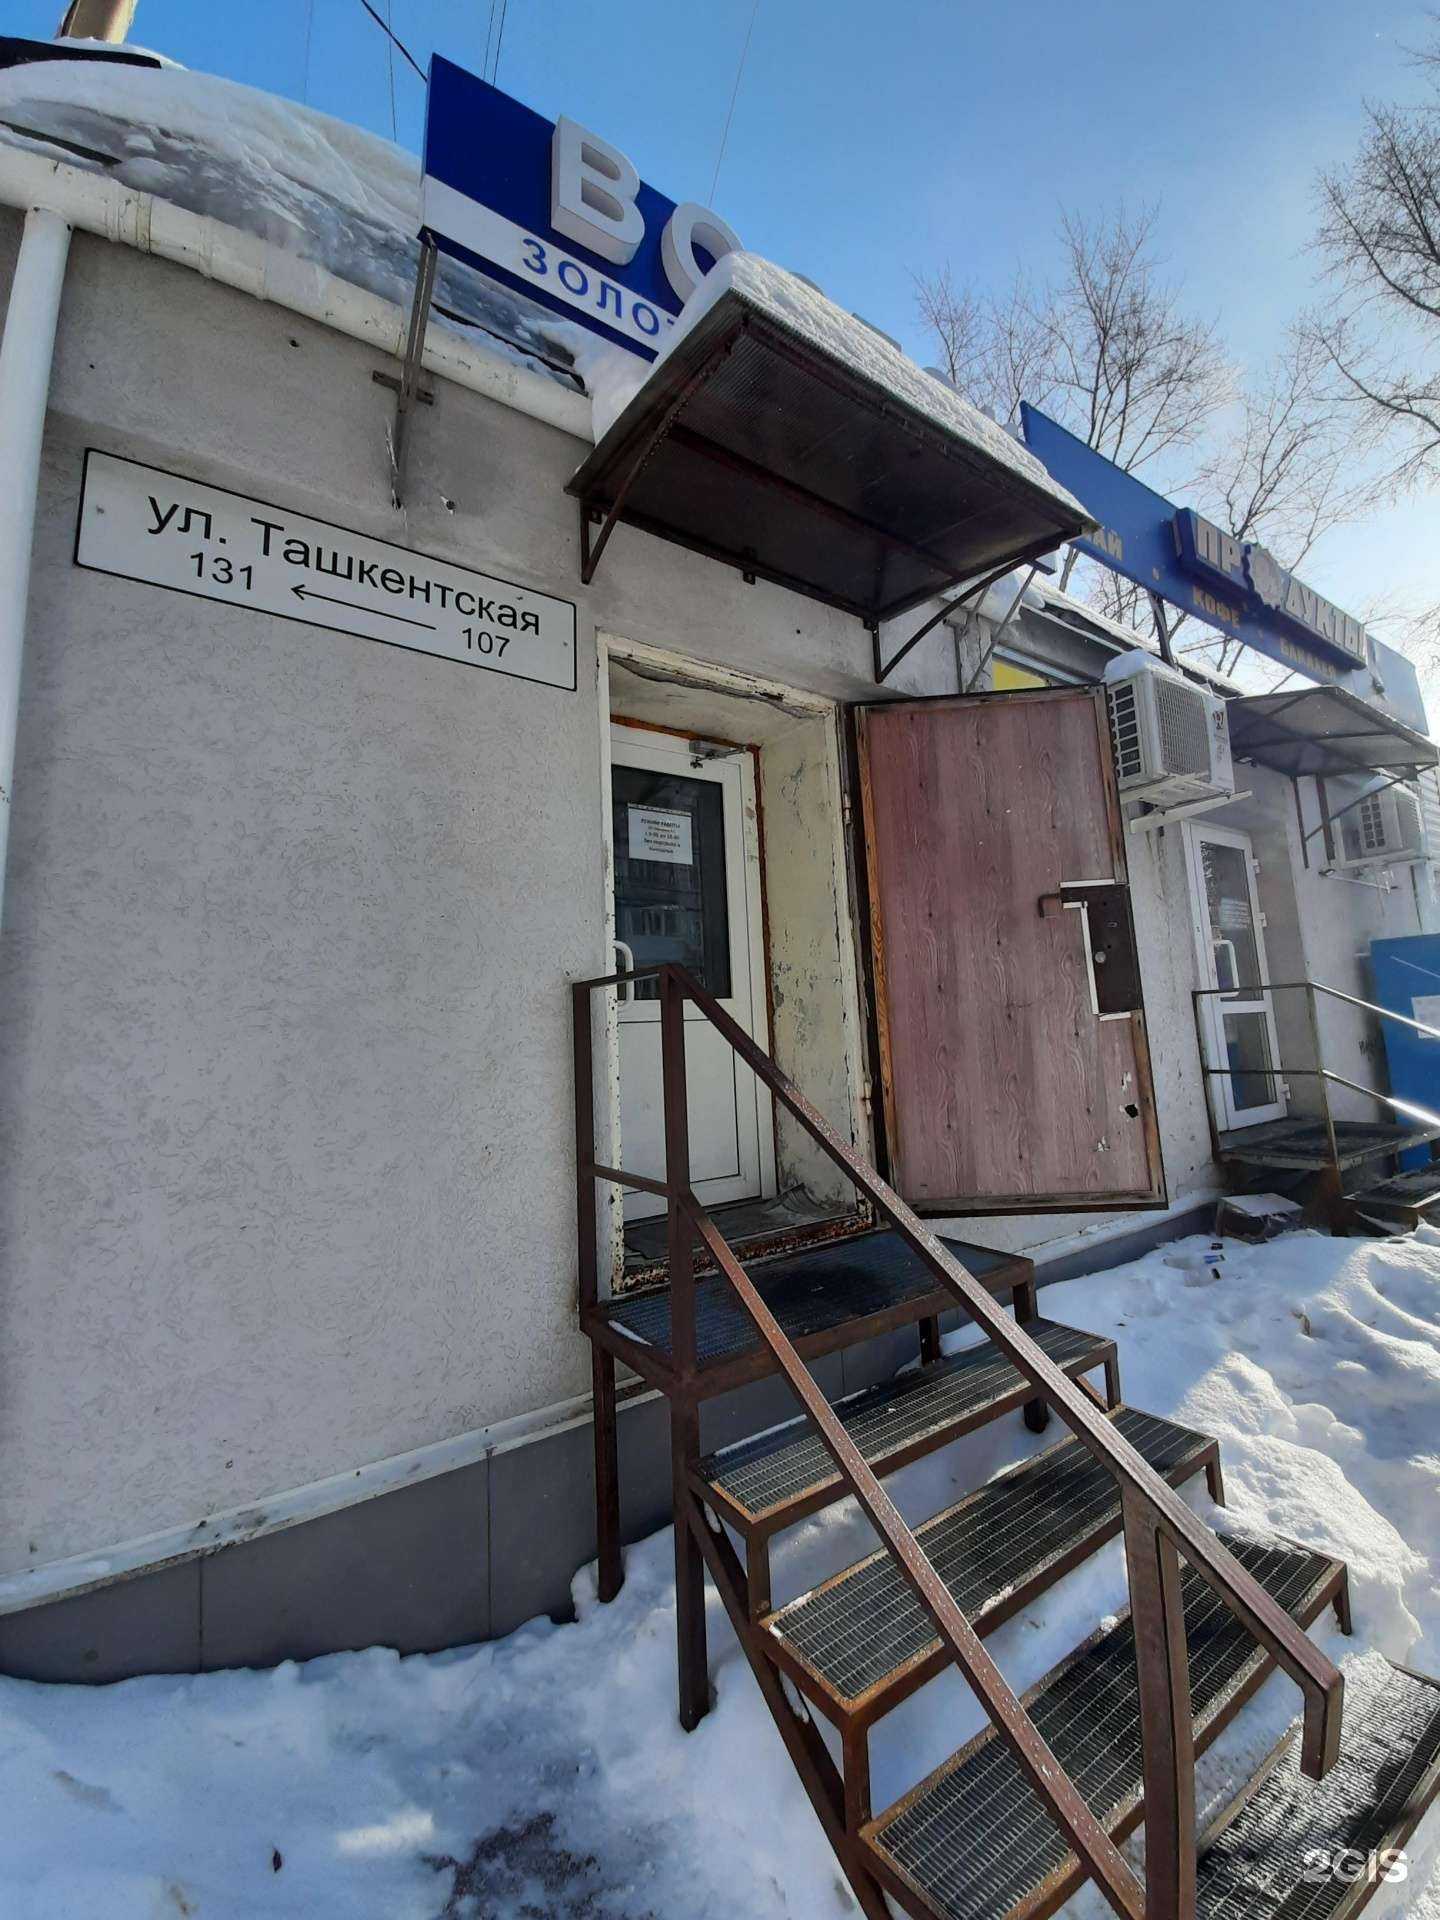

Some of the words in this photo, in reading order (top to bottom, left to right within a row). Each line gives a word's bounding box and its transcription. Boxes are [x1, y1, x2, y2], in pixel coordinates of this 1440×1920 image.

[521, 238, 676, 336] ЗОЛО
[147, 496, 227, 545] ул.
[251, 517, 540, 636] Ташкентская
[190, 551, 254, 591] 131
[461, 627, 510, 658] 107
